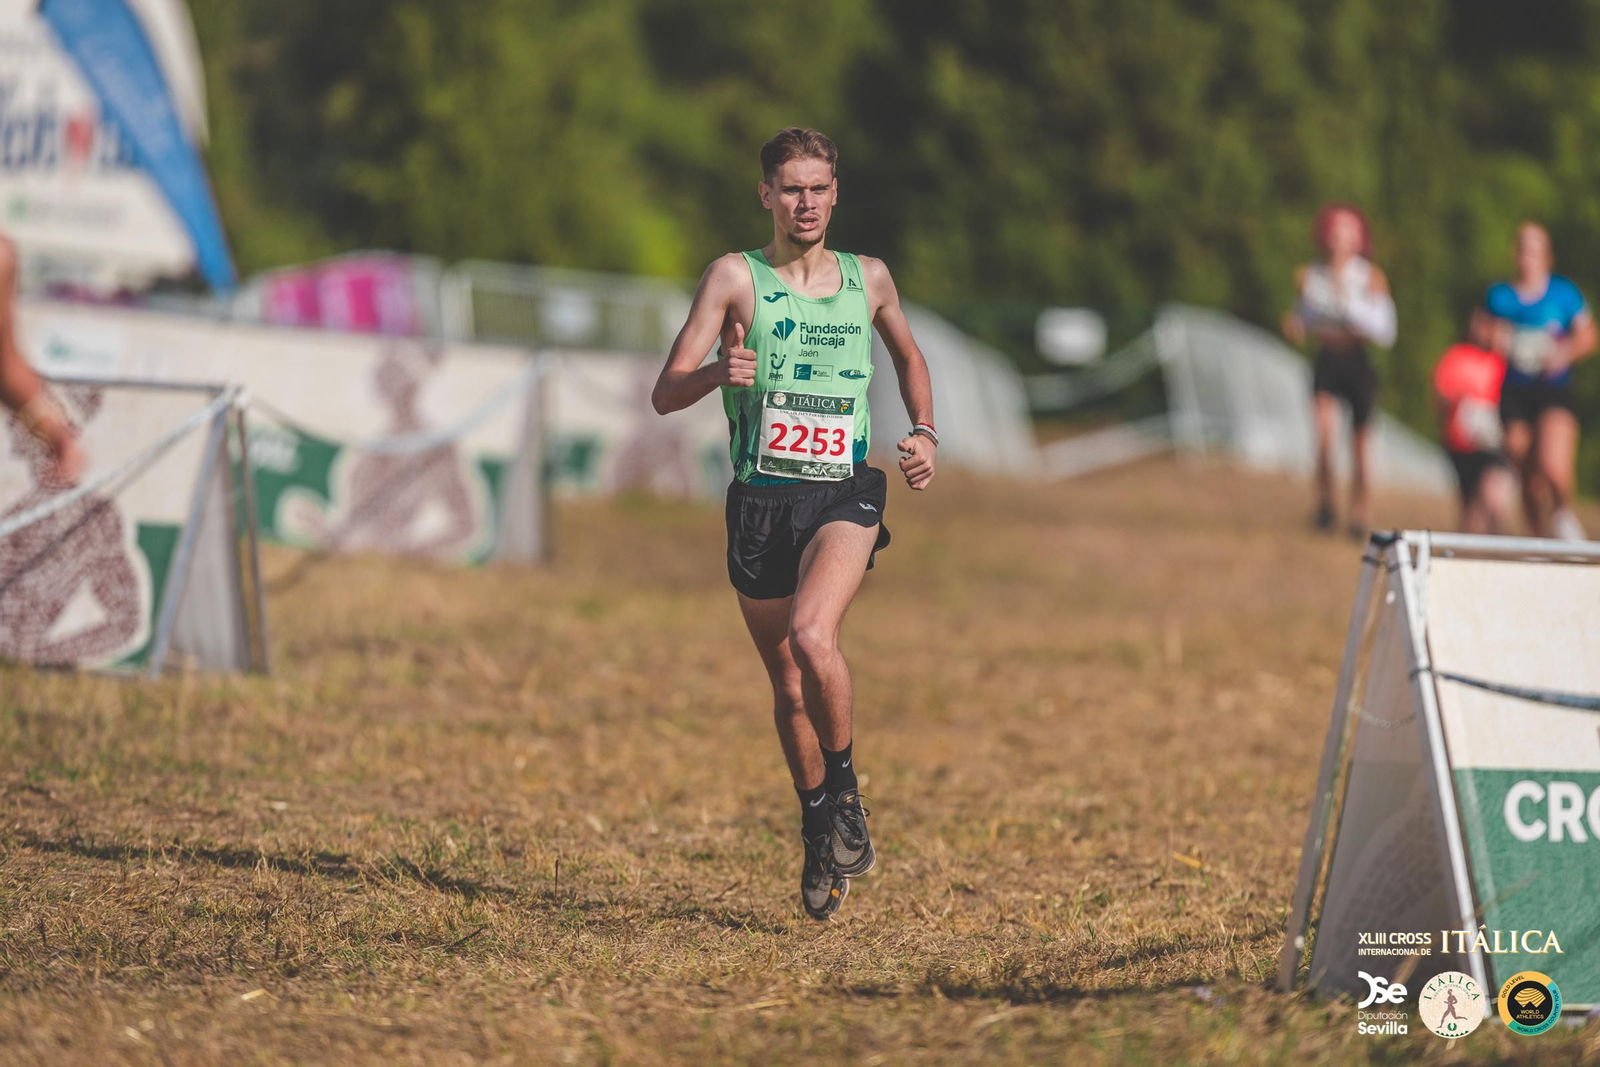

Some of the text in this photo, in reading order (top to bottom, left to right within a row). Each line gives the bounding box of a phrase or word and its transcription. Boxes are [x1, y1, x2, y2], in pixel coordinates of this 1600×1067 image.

[800, 322, 861, 335] Fundación
[800, 334, 845, 349] Unicaja
[798, 349, 818, 358] Jaén
[792, 395, 836, 409] ITÁLICA
[768, 423, 845, 456] 2253
